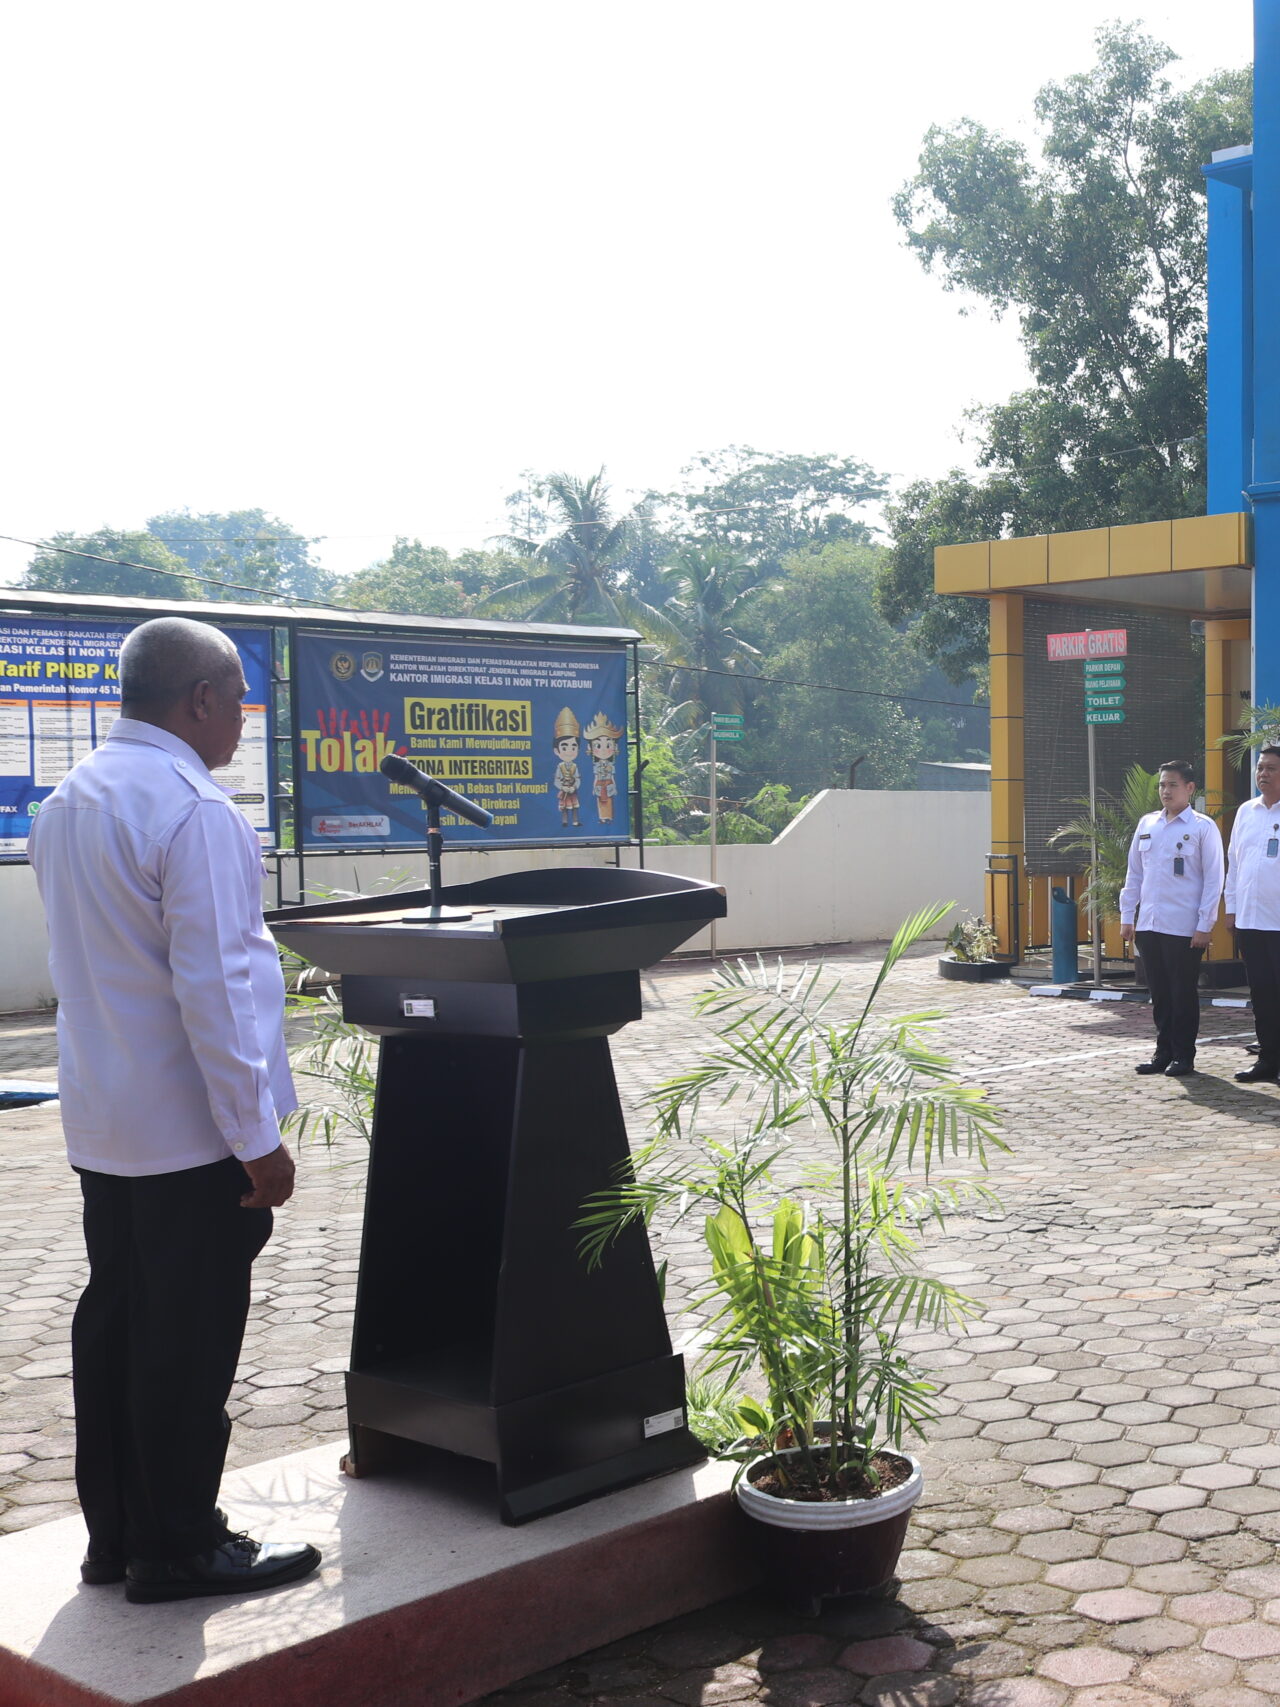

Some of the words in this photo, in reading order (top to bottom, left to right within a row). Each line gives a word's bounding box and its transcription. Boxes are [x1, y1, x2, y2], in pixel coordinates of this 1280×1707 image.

[31, 630, 105, 639] PEMASYARAKATAN
[40, 639, 81, 647] JENDERAL
[1049, 636, 1085, 657] PARKIR
[1088, 632, 1125, 654] GRATIS
[26, 646, 65, 656] KELAS
[68, 648, 76, 656] II
[79, 648, 105, 657] NON
[389, 654, 437, 663] KEMENTERIAN
[438, 656, 465, 664] IMIGRASI
[482, 658, 537, 667] PEMASYARAKATAN
[538, 661, 568, 669] REPUBLIK
[568, 662, 600, 670] INDONESIA
[1085, 664, 1103, 672] PARKIR
[1104, 663, 1121, 671] DEPAN
[0, 660, 41, 678] Tarif
[46, 662, 100, 679] PNBP
[389, 663, 417, 671] KANTOR
[418, 664, 446, 672] WILAYAH
[447, 665, 486, 673] DIREKTORAT
[389, 672, 428, 683] KANTOR
[430, 674, 472, 685] IMIGRASI
[474, 675, 503, 686] KELAS
[505, 676, 511, 686] II
[513, 677, 532, 687] NON
[534, 678, 548, 688] TPI
[550, 679, 592, 689] KOTABUMI
[13, 683, 67, 694] Pemerintah
[68, 685, 98, 694] Nomor
[99, 685, 110, 694] 45
[1087, 696, 1121, 706] TOILET
[410, 701, 527, 732] Gratifikasi
[1086, 713, 1121, 722] KELUAR
[410, 737, 437, 749] Bantu
[439, 737, 463, 749] Kami
[465, 738, 531, 751] Mewujudkanya
[300, 730, 396, 773] Tolak
[449, 759, 530, 775] INTERGRITAS
[467, 783, 494, 794] Bebas
[496, 783, 513, 794] Dari
[515, 783, 548, 795] Korupsi
[481, 799, 520, 810] Birokrasi
